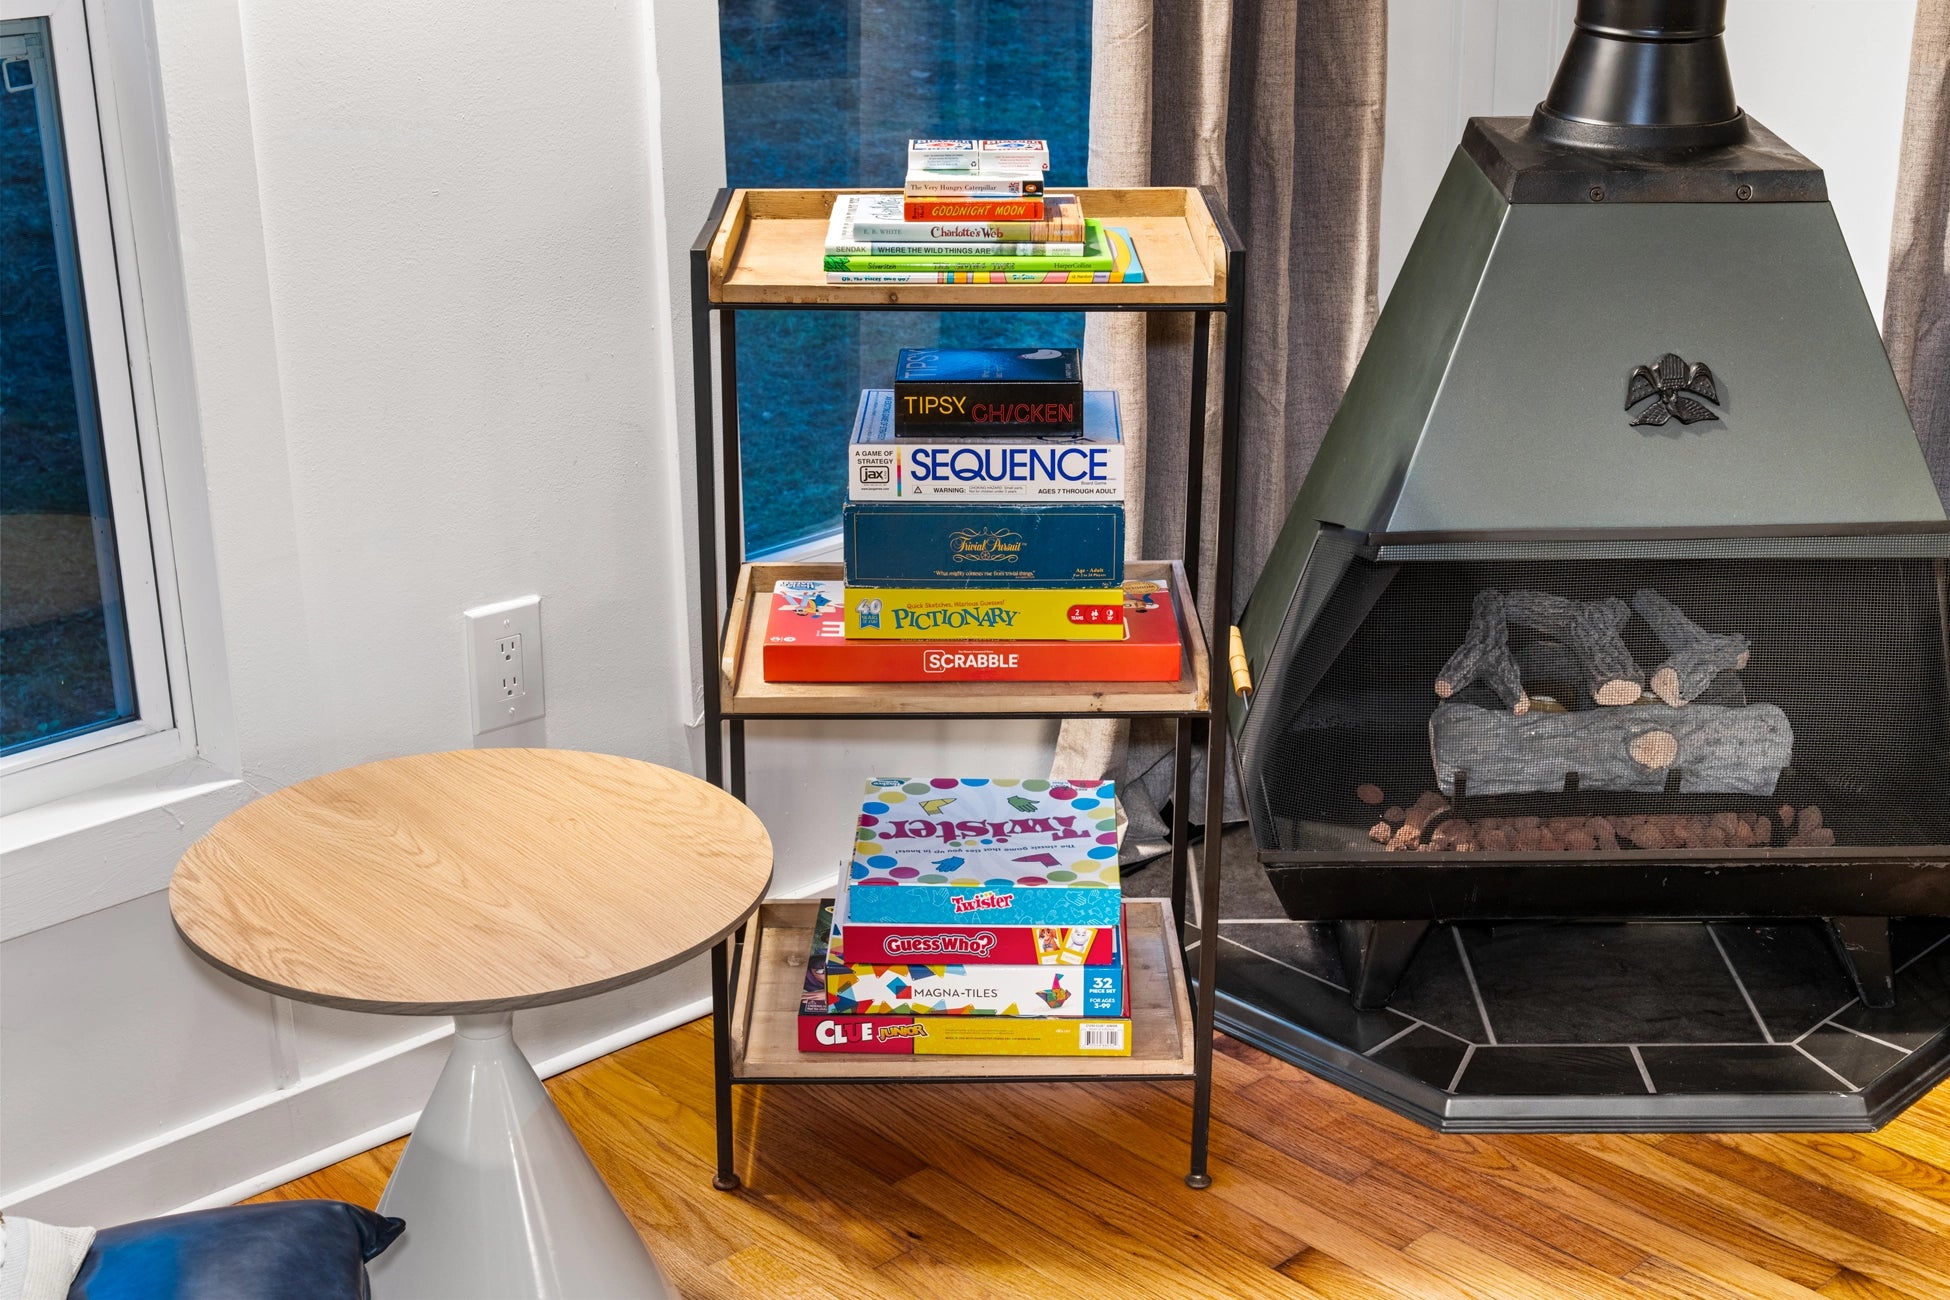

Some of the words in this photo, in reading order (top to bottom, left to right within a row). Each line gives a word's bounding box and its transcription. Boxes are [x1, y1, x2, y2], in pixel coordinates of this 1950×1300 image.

[924, 184, 938, 193] Very
[940, 184, 963, 193] Hungry
[964, 184, 997, 193] Caterpillar
[931, 205, 991, 216] GOODNIGHT
[995, 205, 1025, 216] MOON
[930, 225, 980, 239] Charlotte's
[980, 226, 1004, 239] Web
[877, 246, 905, 254] WHERE
[907, 246, 922, 254] THE
[975, 247, 991, 255] ARE
[1053, 262, 1092, 270] HarperCollins
[903, 349, 940, 379] TIPSY
[904, 396, 966, 415] TIPSY
[971, 403, 1075, 423] CHICKEN
[911, 448, 1107, 482] SEQUENCE
[863, 468, 884, 482] jax
[950, 536, 988, 552] Trivial
[988, 536, 1021, 552] Pursuit
[855, 598, 883, 614] 40
[891, 607, 1017, 630] PICTIONARY
[929, 653, 1018, 669] SCRABBLE
[878, 815, 1091, 844] Twister
[951, 893, 1013, 912] Twister
[886, 936, 940, 953] Guess
[941, 934, 994, 955] Who?
[1093, 977, 1113, 989] 32
[914, 988, 998, 998] MAGNA-TILES
[815, 1020, 873, 1046] CLUE
[879, 1024, 928, 1042] JUNIOR
